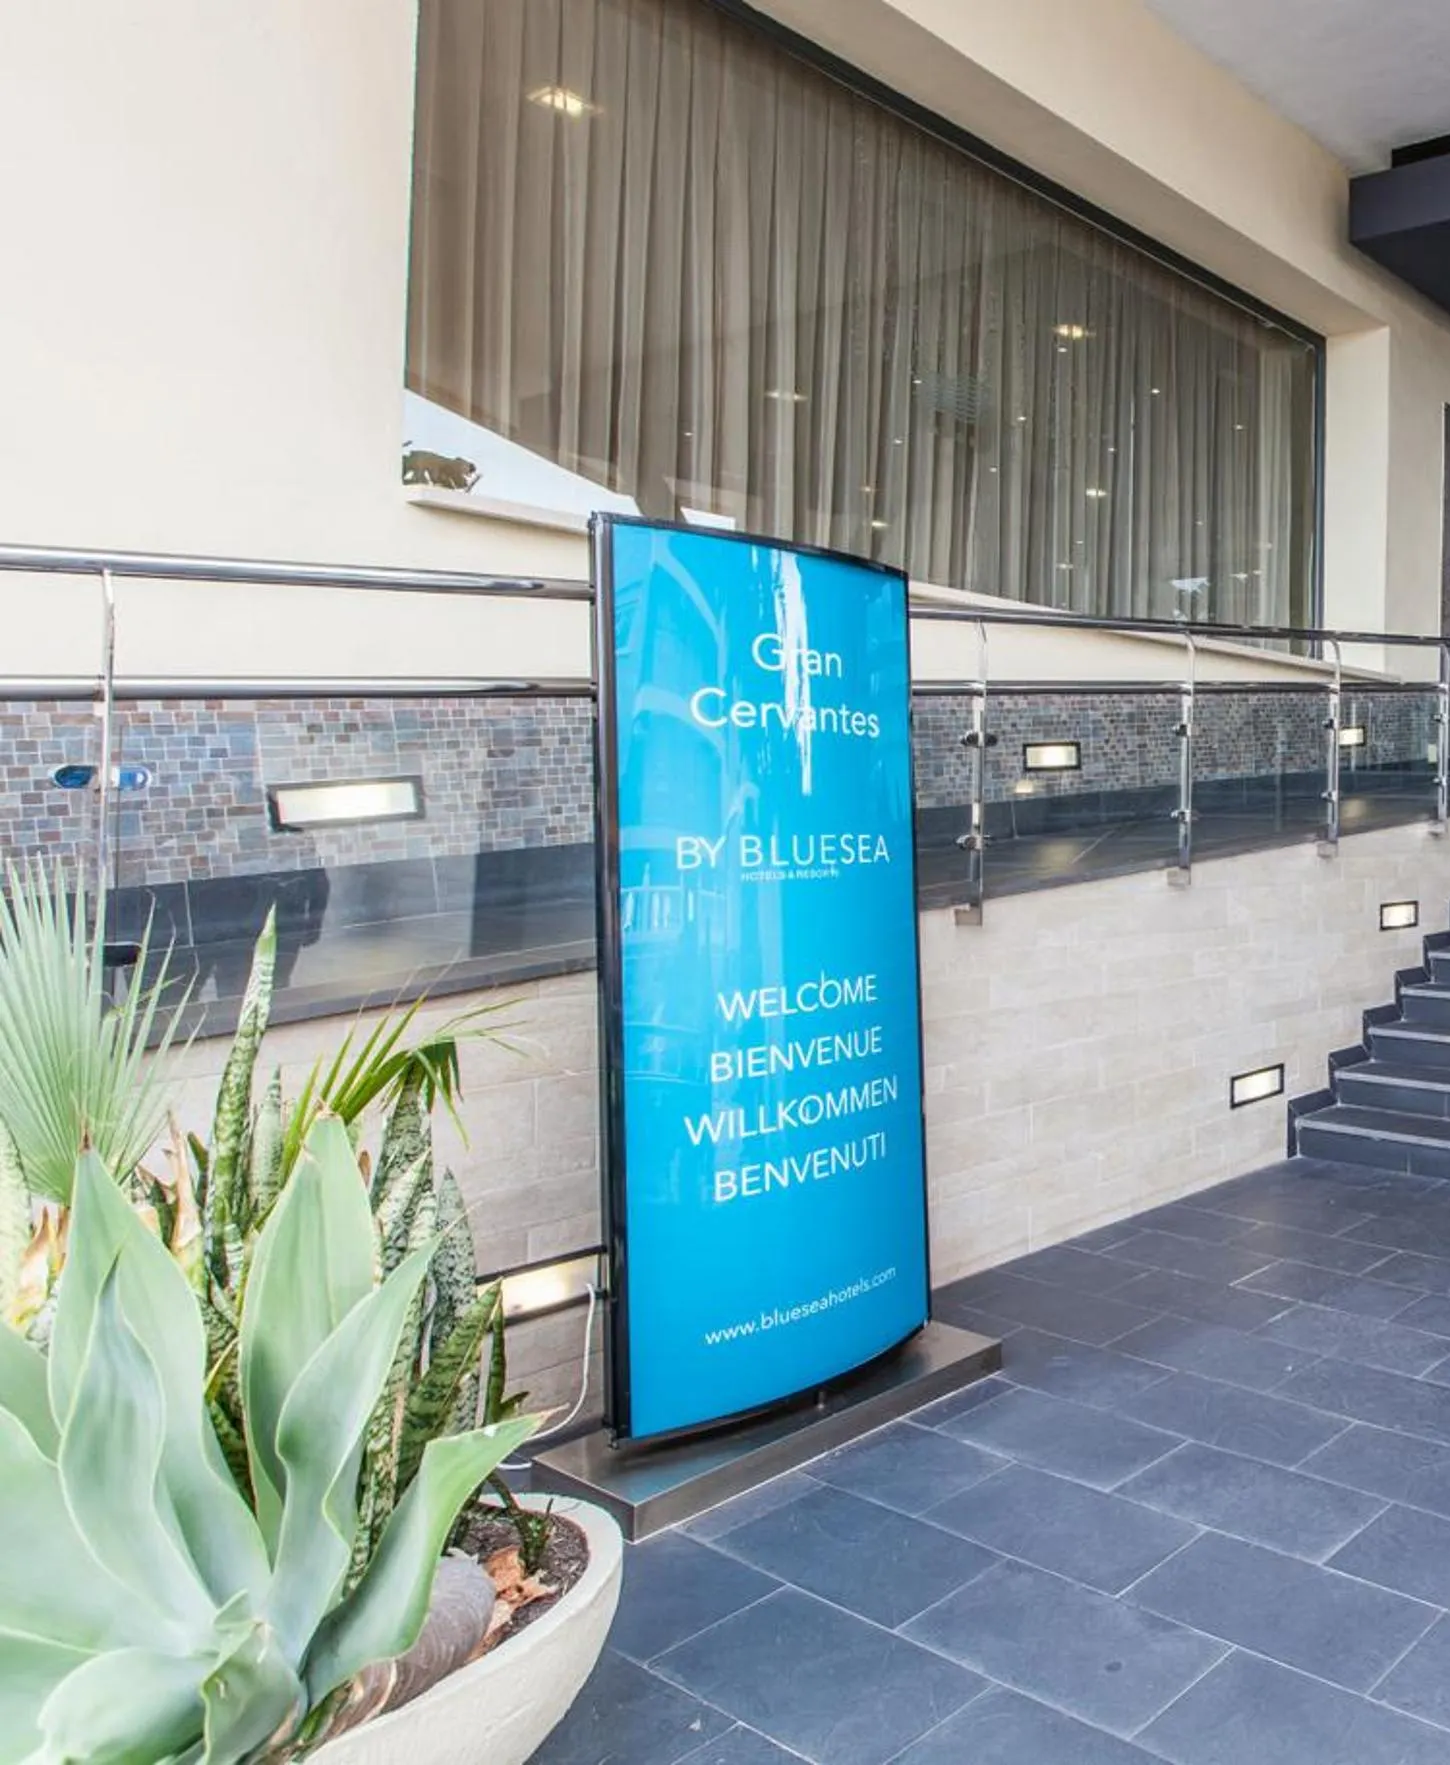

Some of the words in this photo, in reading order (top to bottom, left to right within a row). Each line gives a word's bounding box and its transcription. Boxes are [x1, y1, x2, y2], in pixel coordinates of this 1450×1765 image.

[690, 686, 881, 739] Cervantes
[676, 836, 726, 869] BY
[740, 834, 891, 868] BLUESEA
[717, 974, 878, 1022] WELCOME
[710, 1026, 883, 1083] BIENVENUE
[684, 1075, 899, 1146] WILLKOMMEN
[714, 1131, 888, 1202] BENVENUTI
[704, 1265, 897, 1346] www.blueseahotels.com
